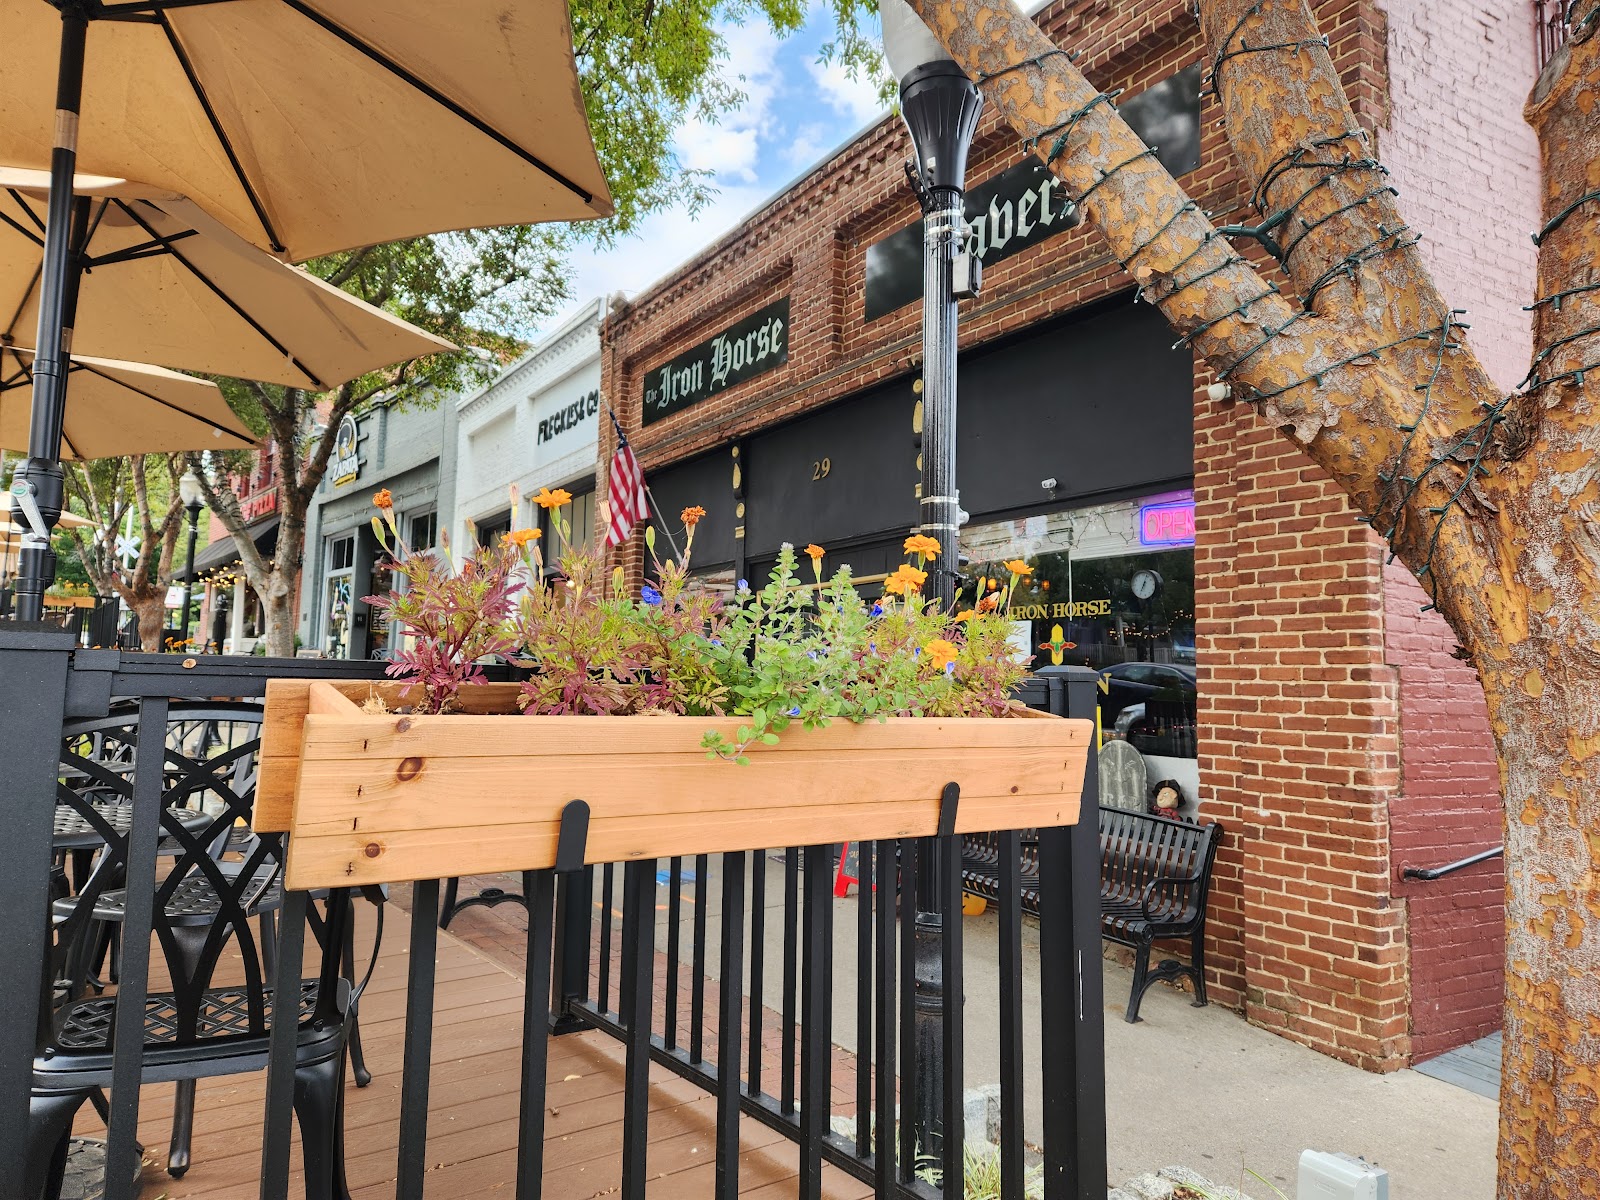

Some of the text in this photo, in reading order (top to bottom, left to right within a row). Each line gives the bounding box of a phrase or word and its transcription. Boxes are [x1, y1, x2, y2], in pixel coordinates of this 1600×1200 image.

[965, 176, 1074, 259] aver
[657, 360, 703, 410] Iron
[709, 317, 784, 391] Horse
[332, 455, 359, 482] ZAPATA
[812, 457, 831, 481] 29
[253, 492, 275, 518] PIZZA
[1145, 508, 1195, 540] OPEN
[1010, 599, 1112, 620] IRON HORSE
